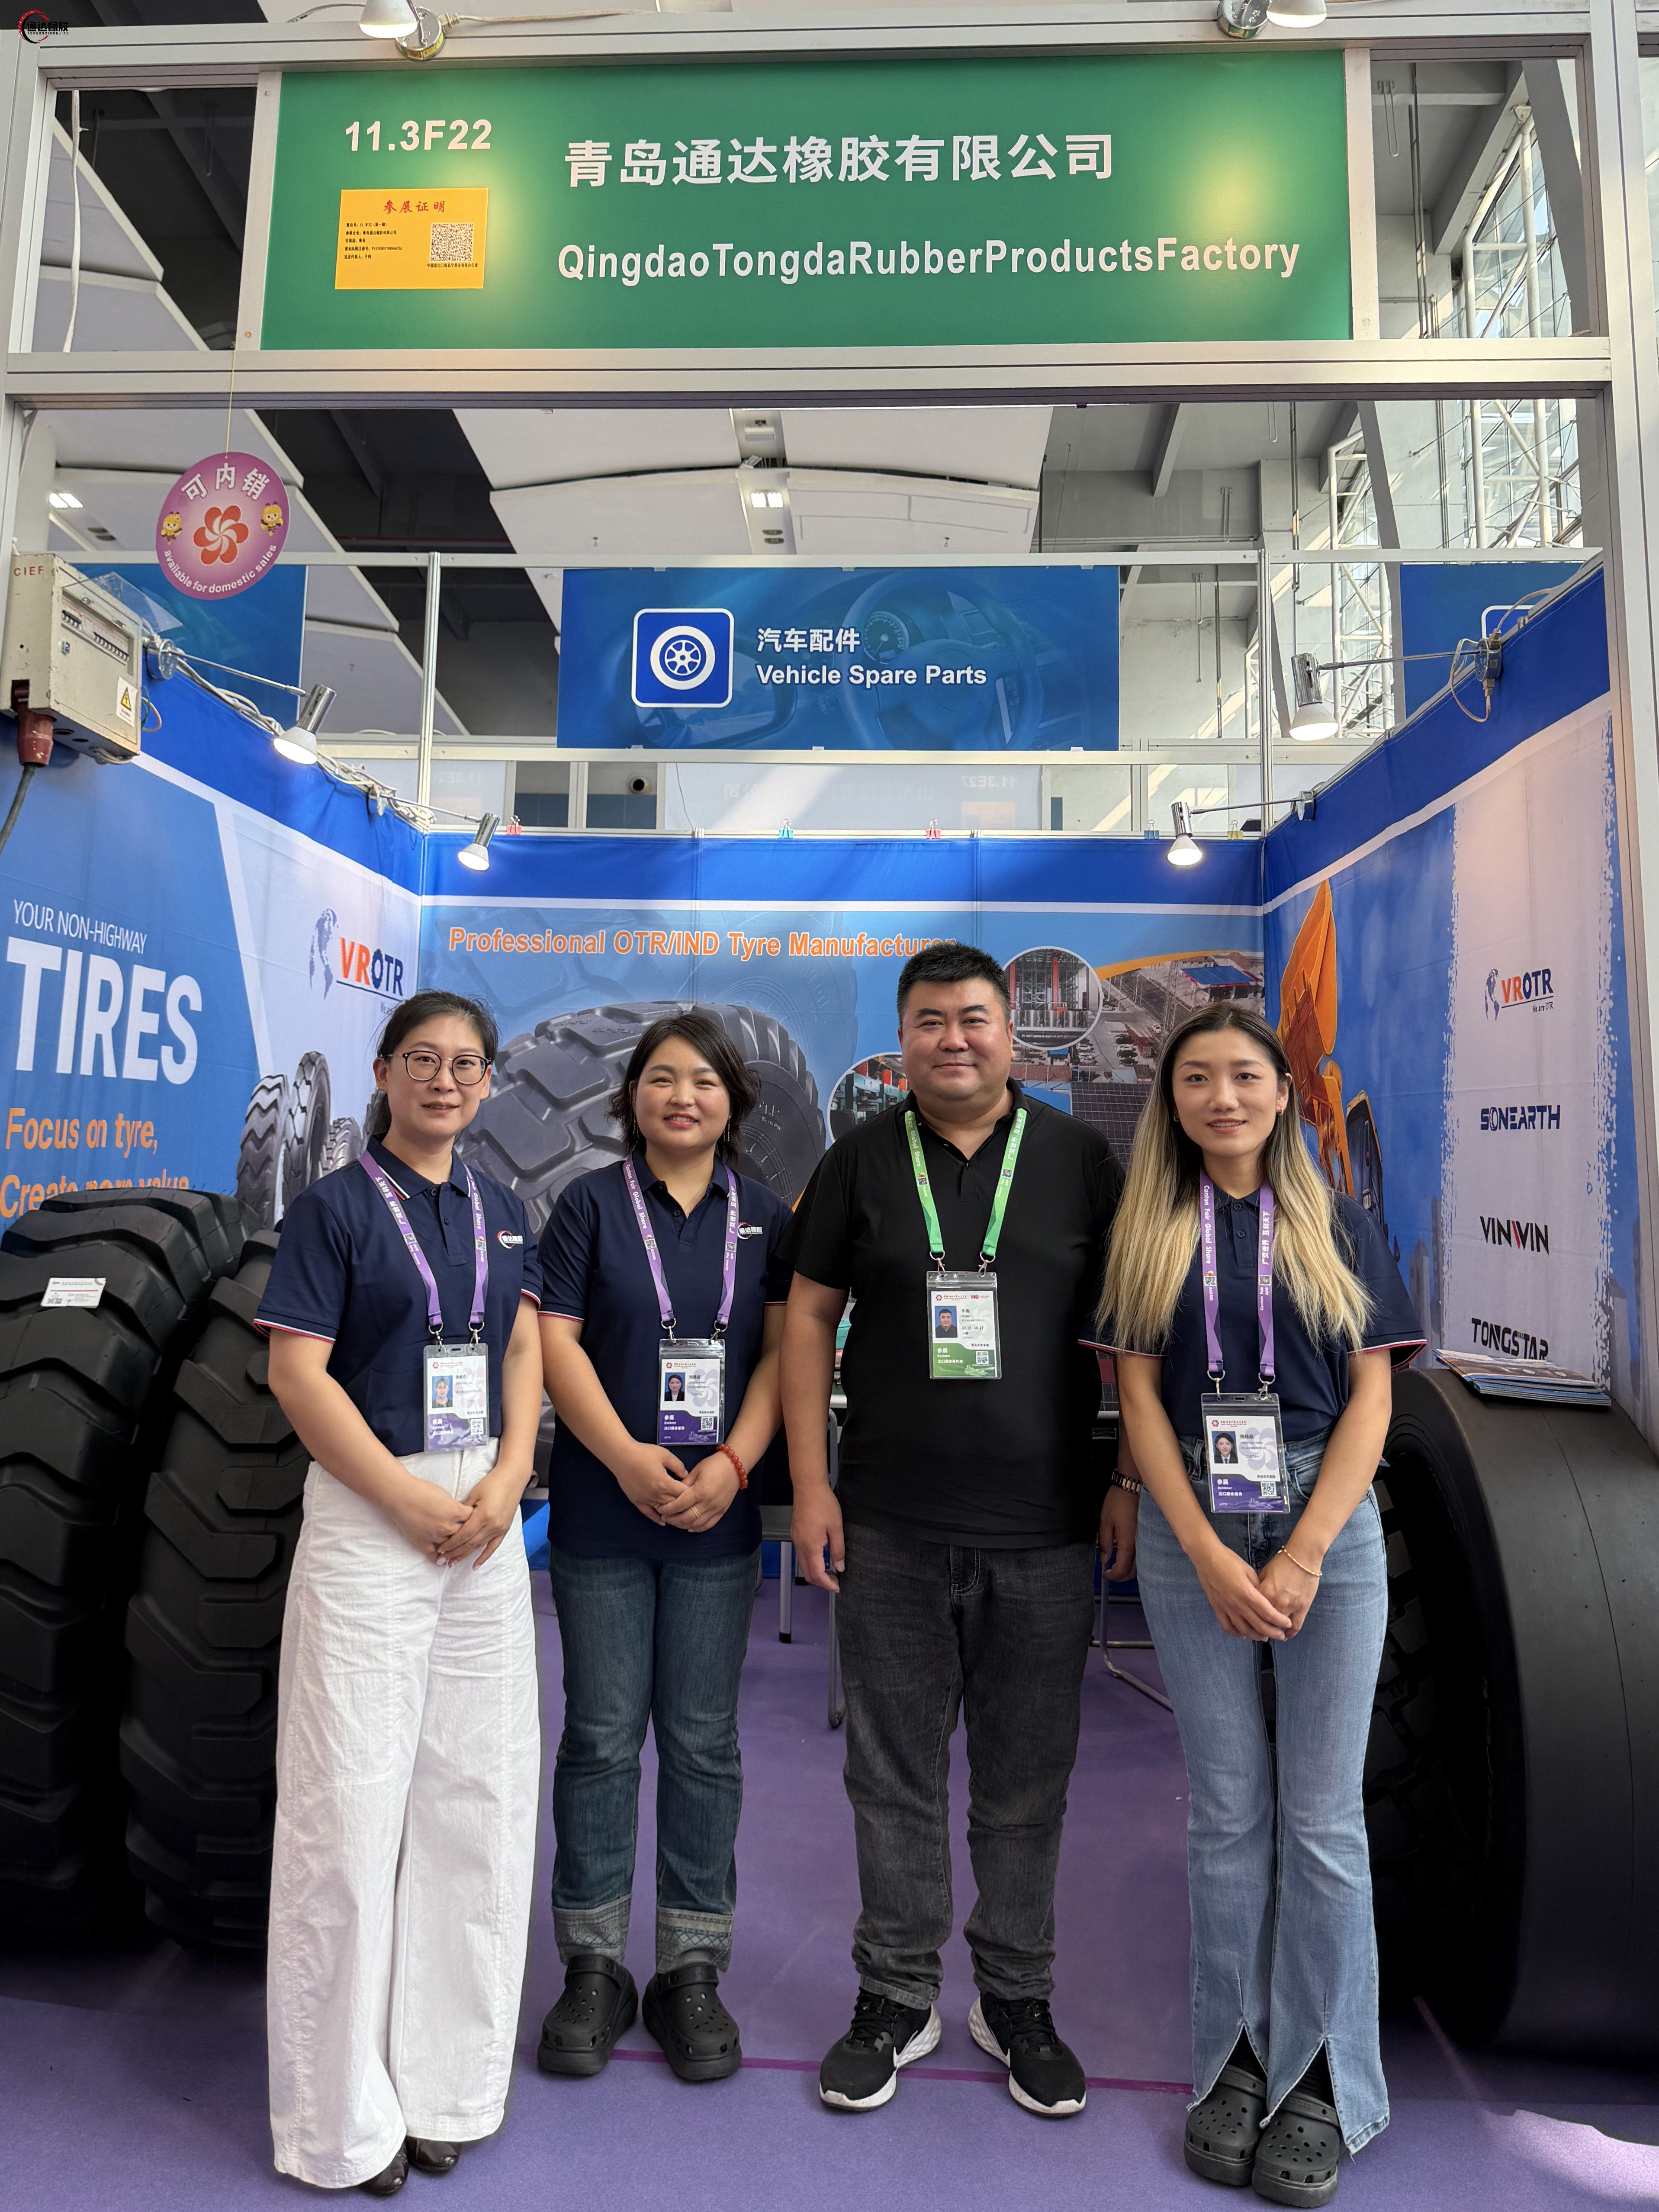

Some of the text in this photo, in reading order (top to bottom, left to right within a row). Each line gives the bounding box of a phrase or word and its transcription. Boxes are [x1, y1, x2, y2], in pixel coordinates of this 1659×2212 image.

[345, 119, 492, 151] 11.3F22
[564, 133, 1112, 187] 青岛通达橡胶有限公司
[383, 200, 446, 214] 参展证明
[558, 236, 1300, 286] QingdaoTongdaRubberProductsFactory
[181, 463, 270, 501] 可内销
[14, 566, 44, 576] CIEF
[164, 544, 276, 594] available for domestic sales
[756, 627, 861, 653] 汽车配件
[756, 664, 987, 690] Vehicle Spare Parts
[14, 899, 147, 955] YOUR NON-HIGHWAY
[448, 926, 605, 955] Professional
[614, 930, 720, 956] OTR/IND
[726, 930, 780, 962] Tyre
[339, 937, 403, 997] VROTR
[1501, 968, 1554, 1003] VROTR
[6, 936, 203, 1085] TIRES
[6, 1107, 158, 1158] Focus on tyre,
[1480, 1105, 1561, 1132] SONEARTH
[633, 1191, 643, 1210] Global
[639, 1212, 648, 1229] Share
[1472, 1318, 1549, 1360] TONGSTAR
